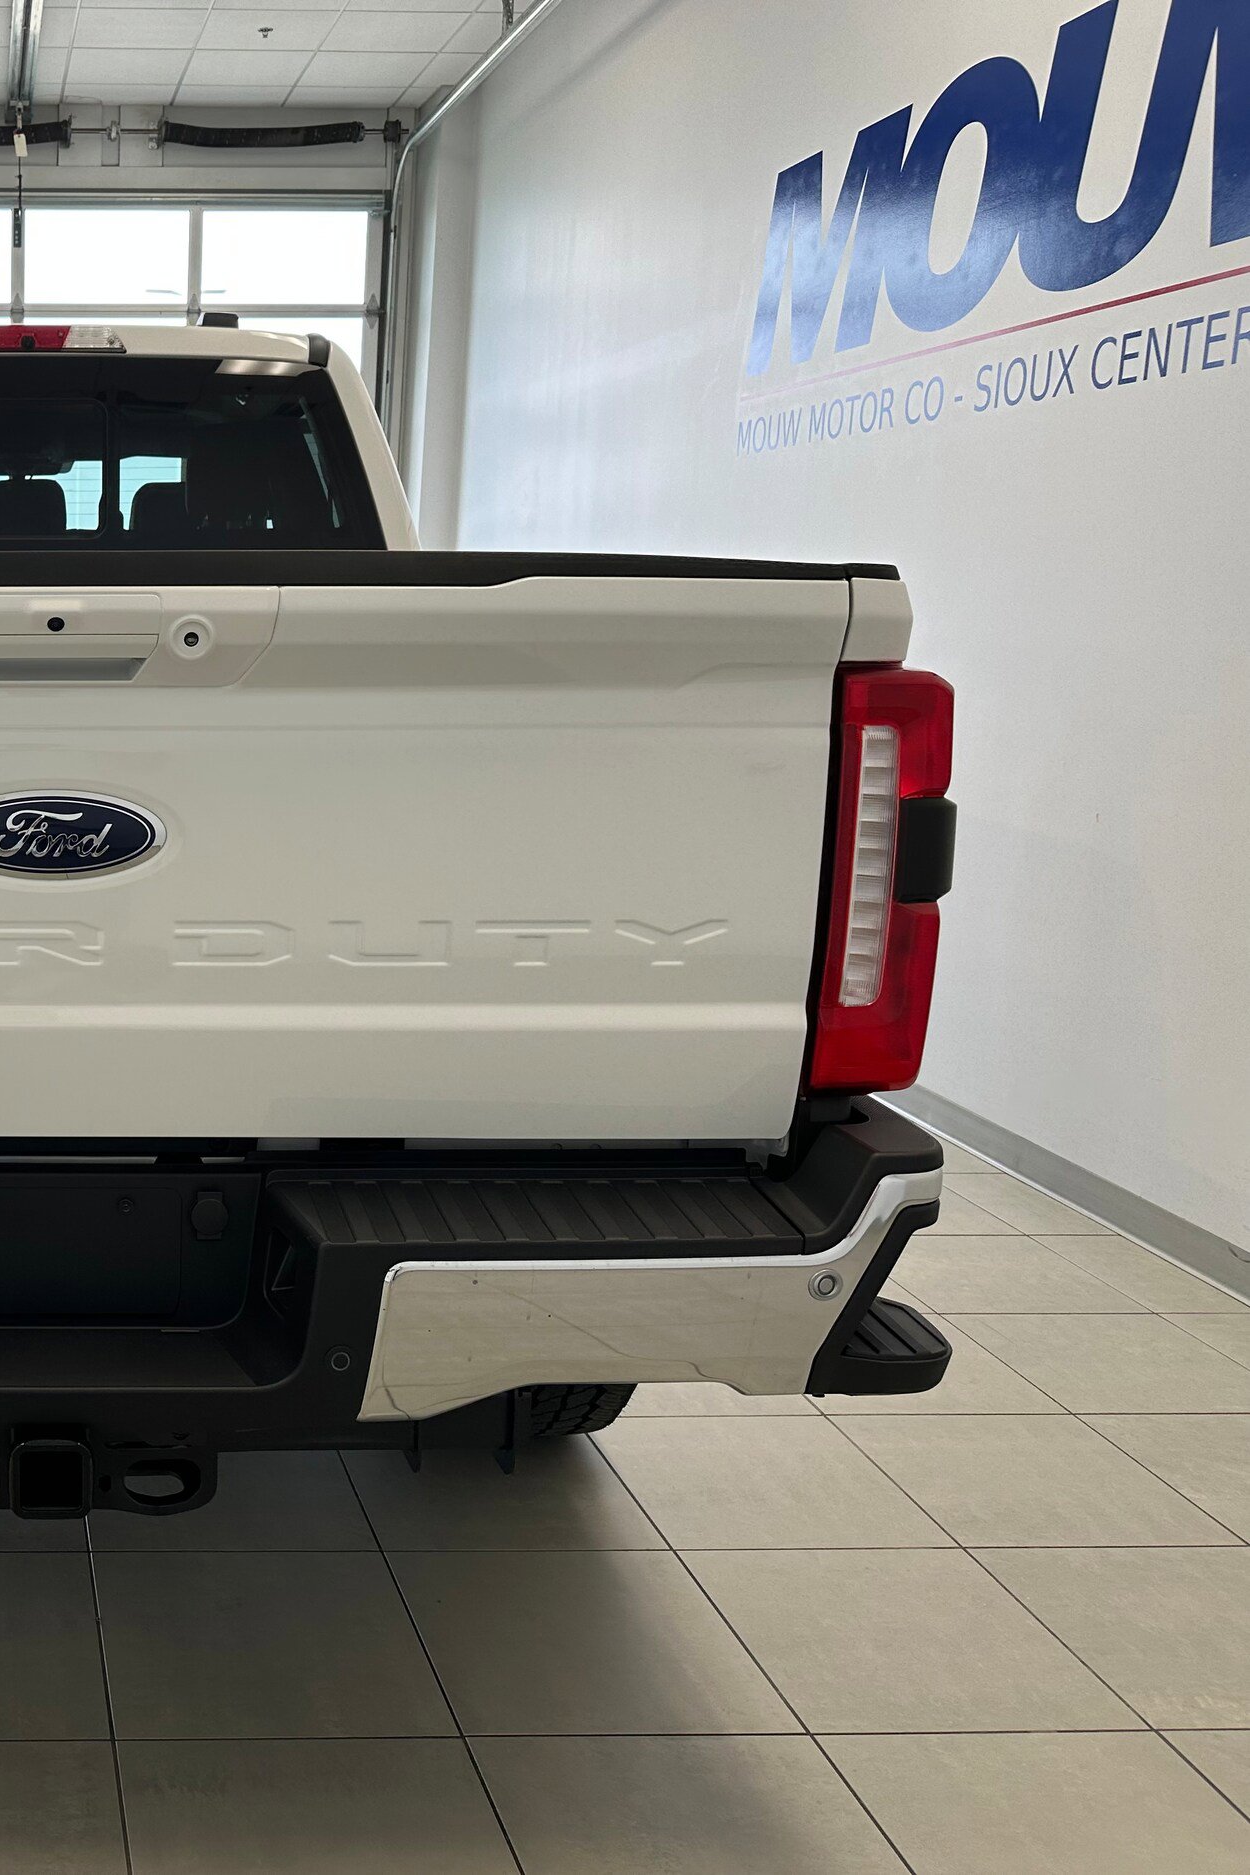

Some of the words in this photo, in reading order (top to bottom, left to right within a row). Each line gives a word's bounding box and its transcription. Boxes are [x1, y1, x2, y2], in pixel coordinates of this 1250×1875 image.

[746, 0, 1250, 377] MOU
[736, 407, 803, 457] MOUW
[808, 387, 895, 443] MOTOR
[904, 376, 945, 425] CO
[973, 344, 1080, 413] SIOUX
[170, 919, 729, 967] DUTY
